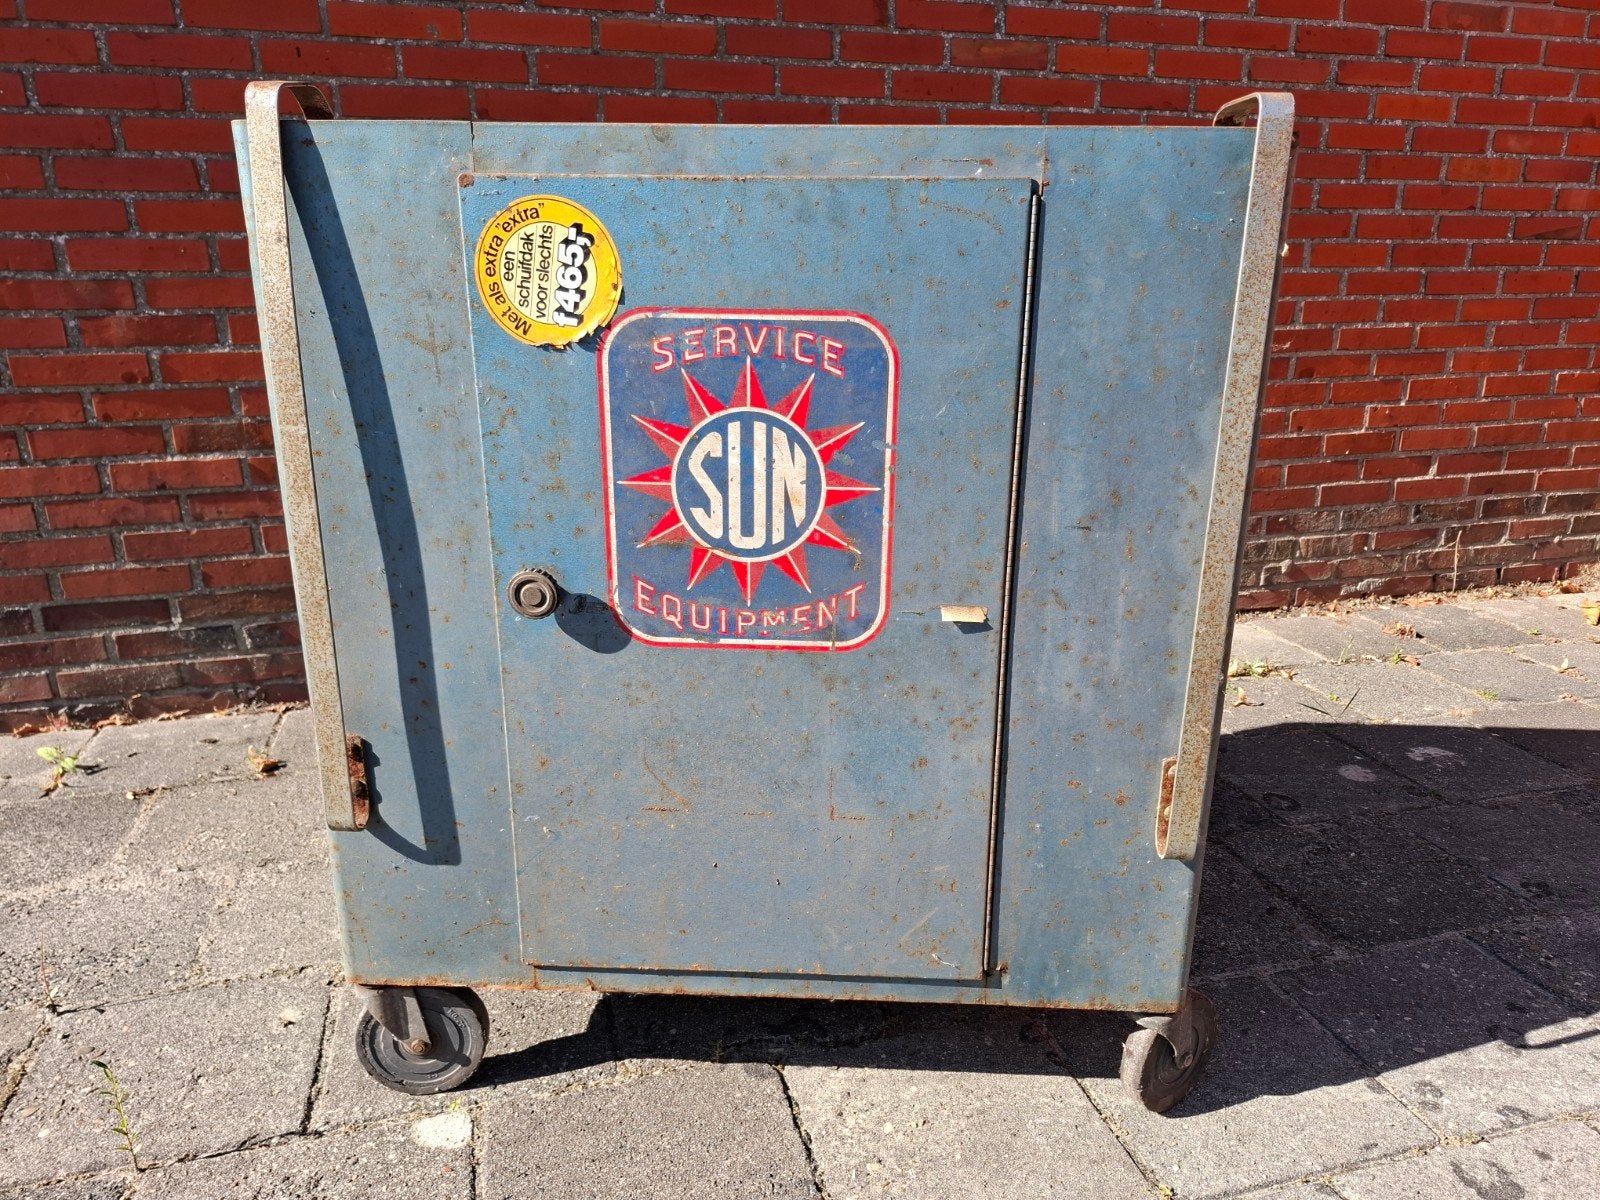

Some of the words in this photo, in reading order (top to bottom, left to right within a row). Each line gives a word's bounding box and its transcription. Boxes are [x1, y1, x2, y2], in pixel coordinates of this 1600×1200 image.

[484, 235, 504, 277] extra
[503, 250, 516, 282] een
[516, 231, 535, 308] schuifdak
[537, 225, 554, 283] slechts
[488, 281, 506, 306] als
[535, 284, 548, 319] voor
[503, 306, 532, 336] Met
[651, 322, 846, 378] SERVICE
[688, 420, 808, 550] SUN
[633, 573, 867, 637] EQUIPMENT
